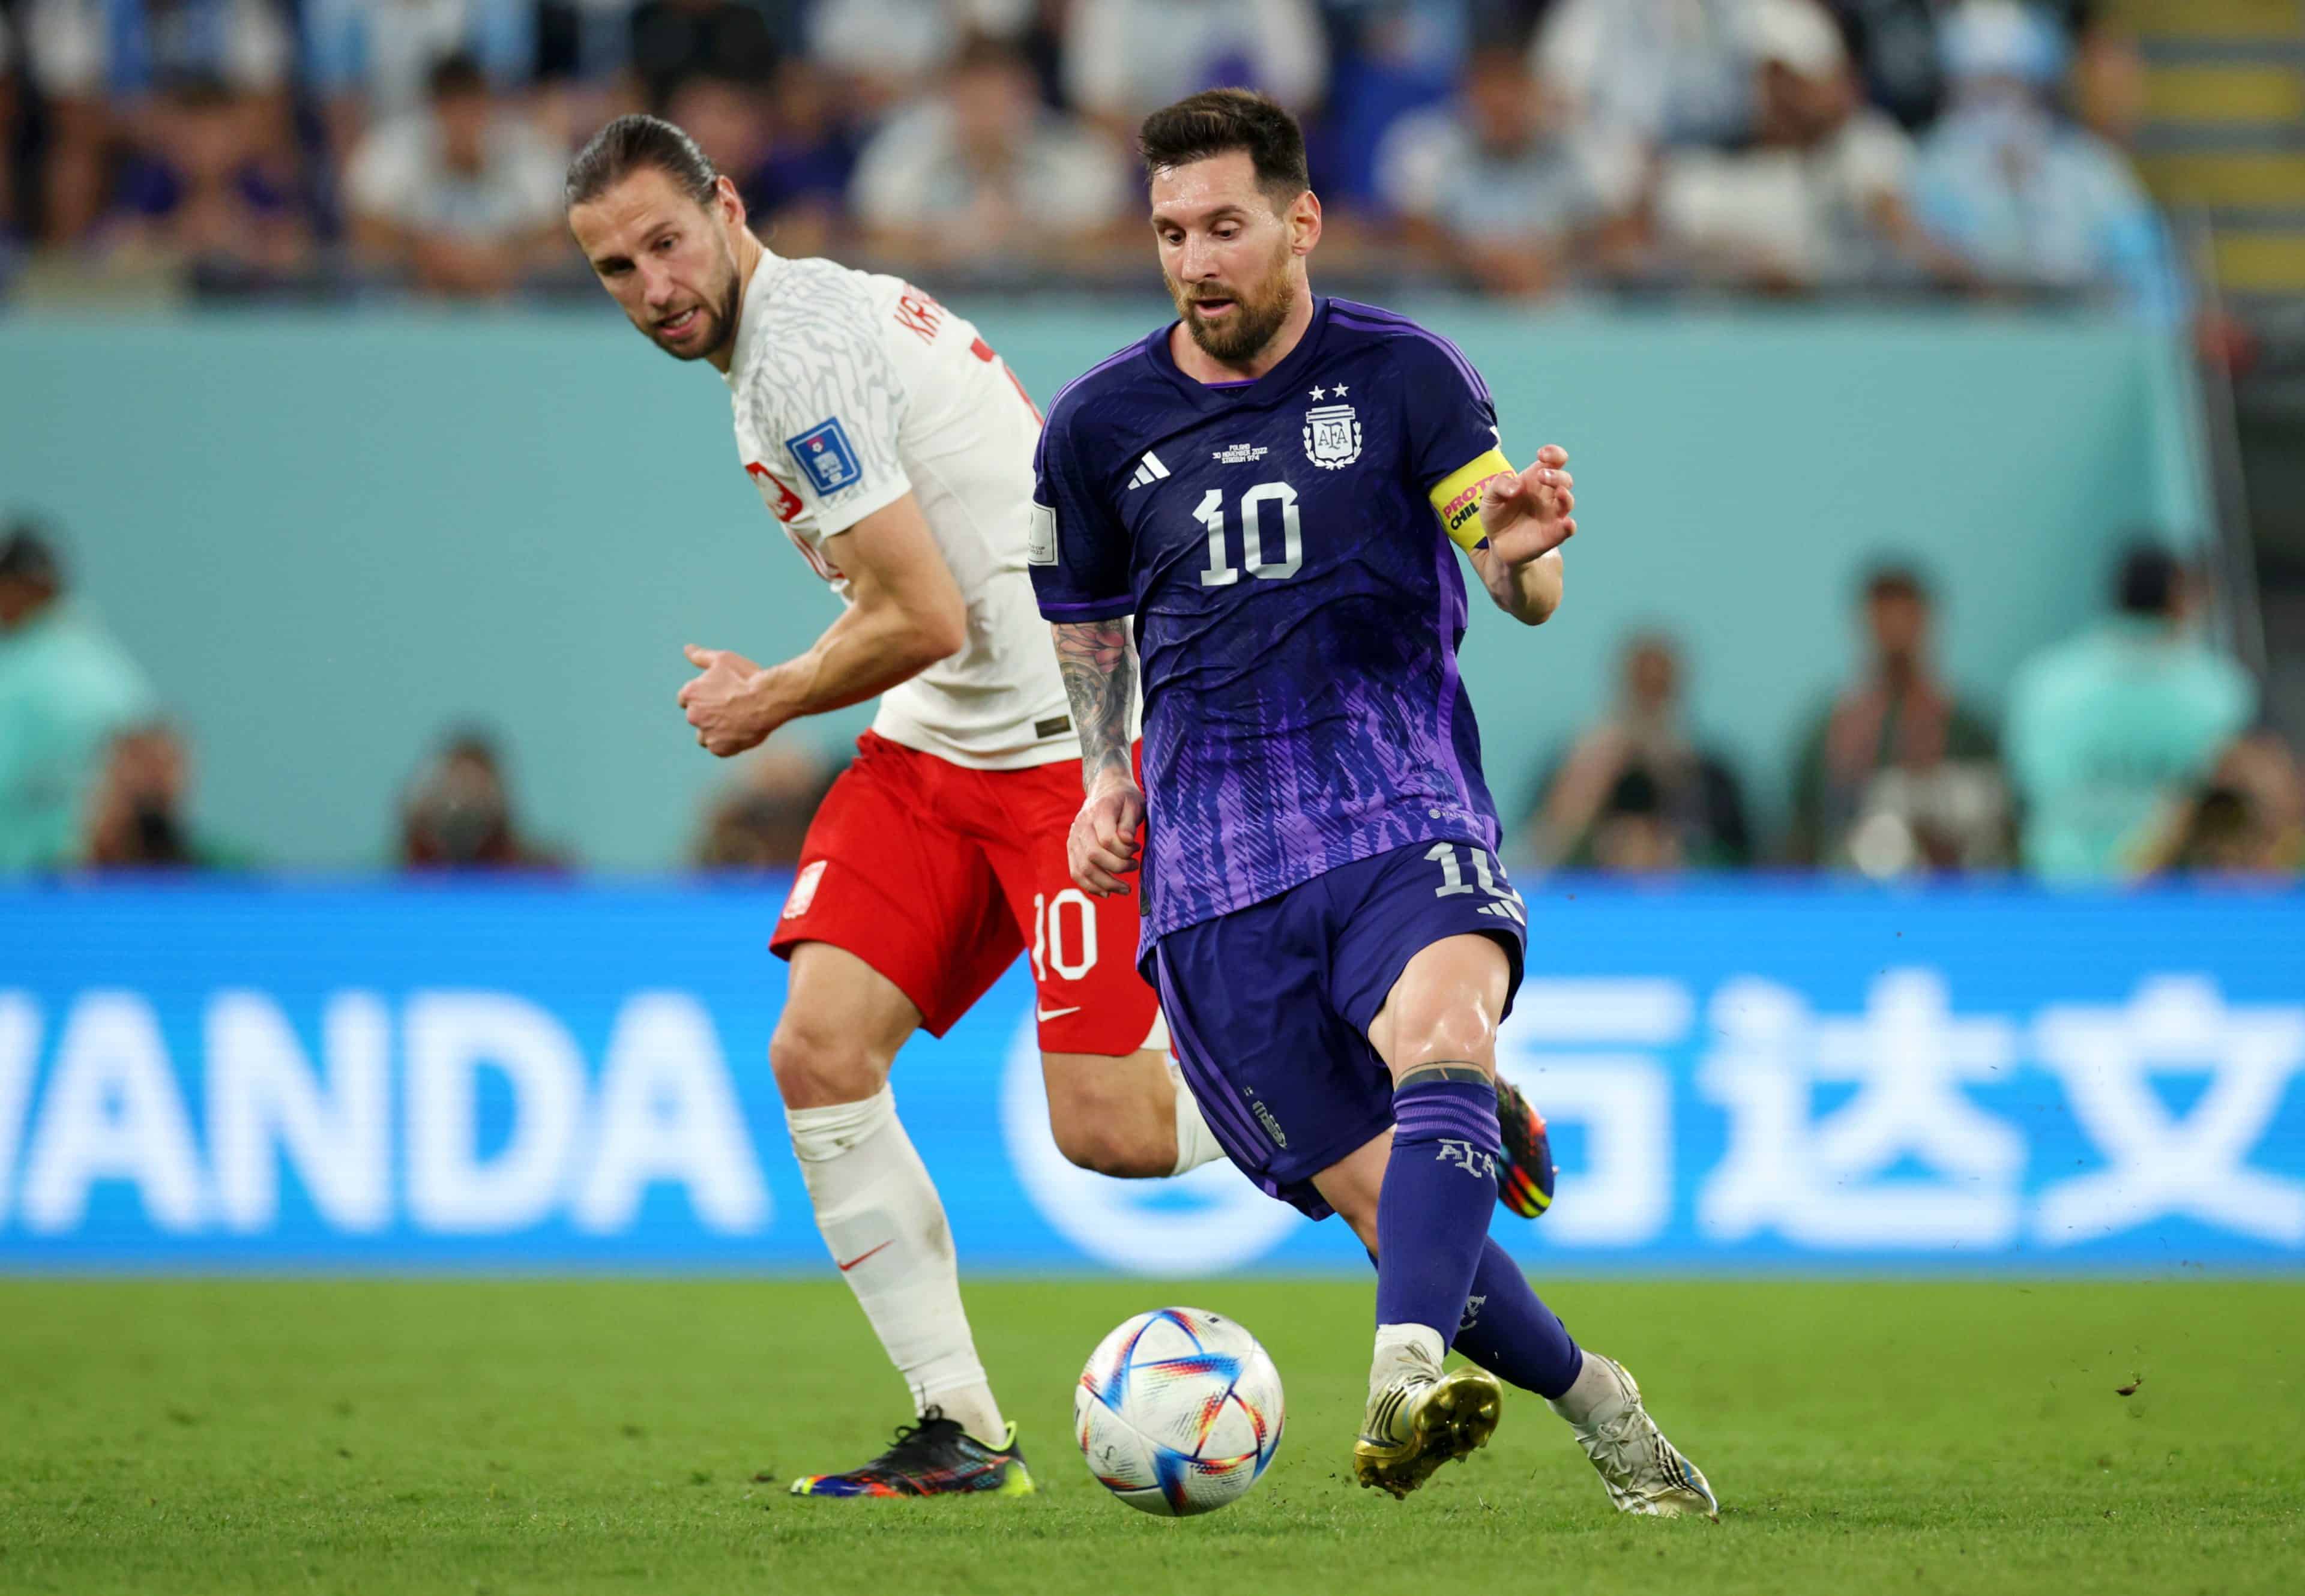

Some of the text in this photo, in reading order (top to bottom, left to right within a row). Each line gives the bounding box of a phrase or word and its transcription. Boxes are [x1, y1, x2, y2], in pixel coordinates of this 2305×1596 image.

[1318, 421, 1348, 450] AFA
[1443, 470, 1516, 519] PROT
[1450, 496, 1483, 530] CHIL
[1192, 481, 1303, 586] 10
[1032, 888, 1097, 981] 10
[0, 989, 774, 1236] ANDA
